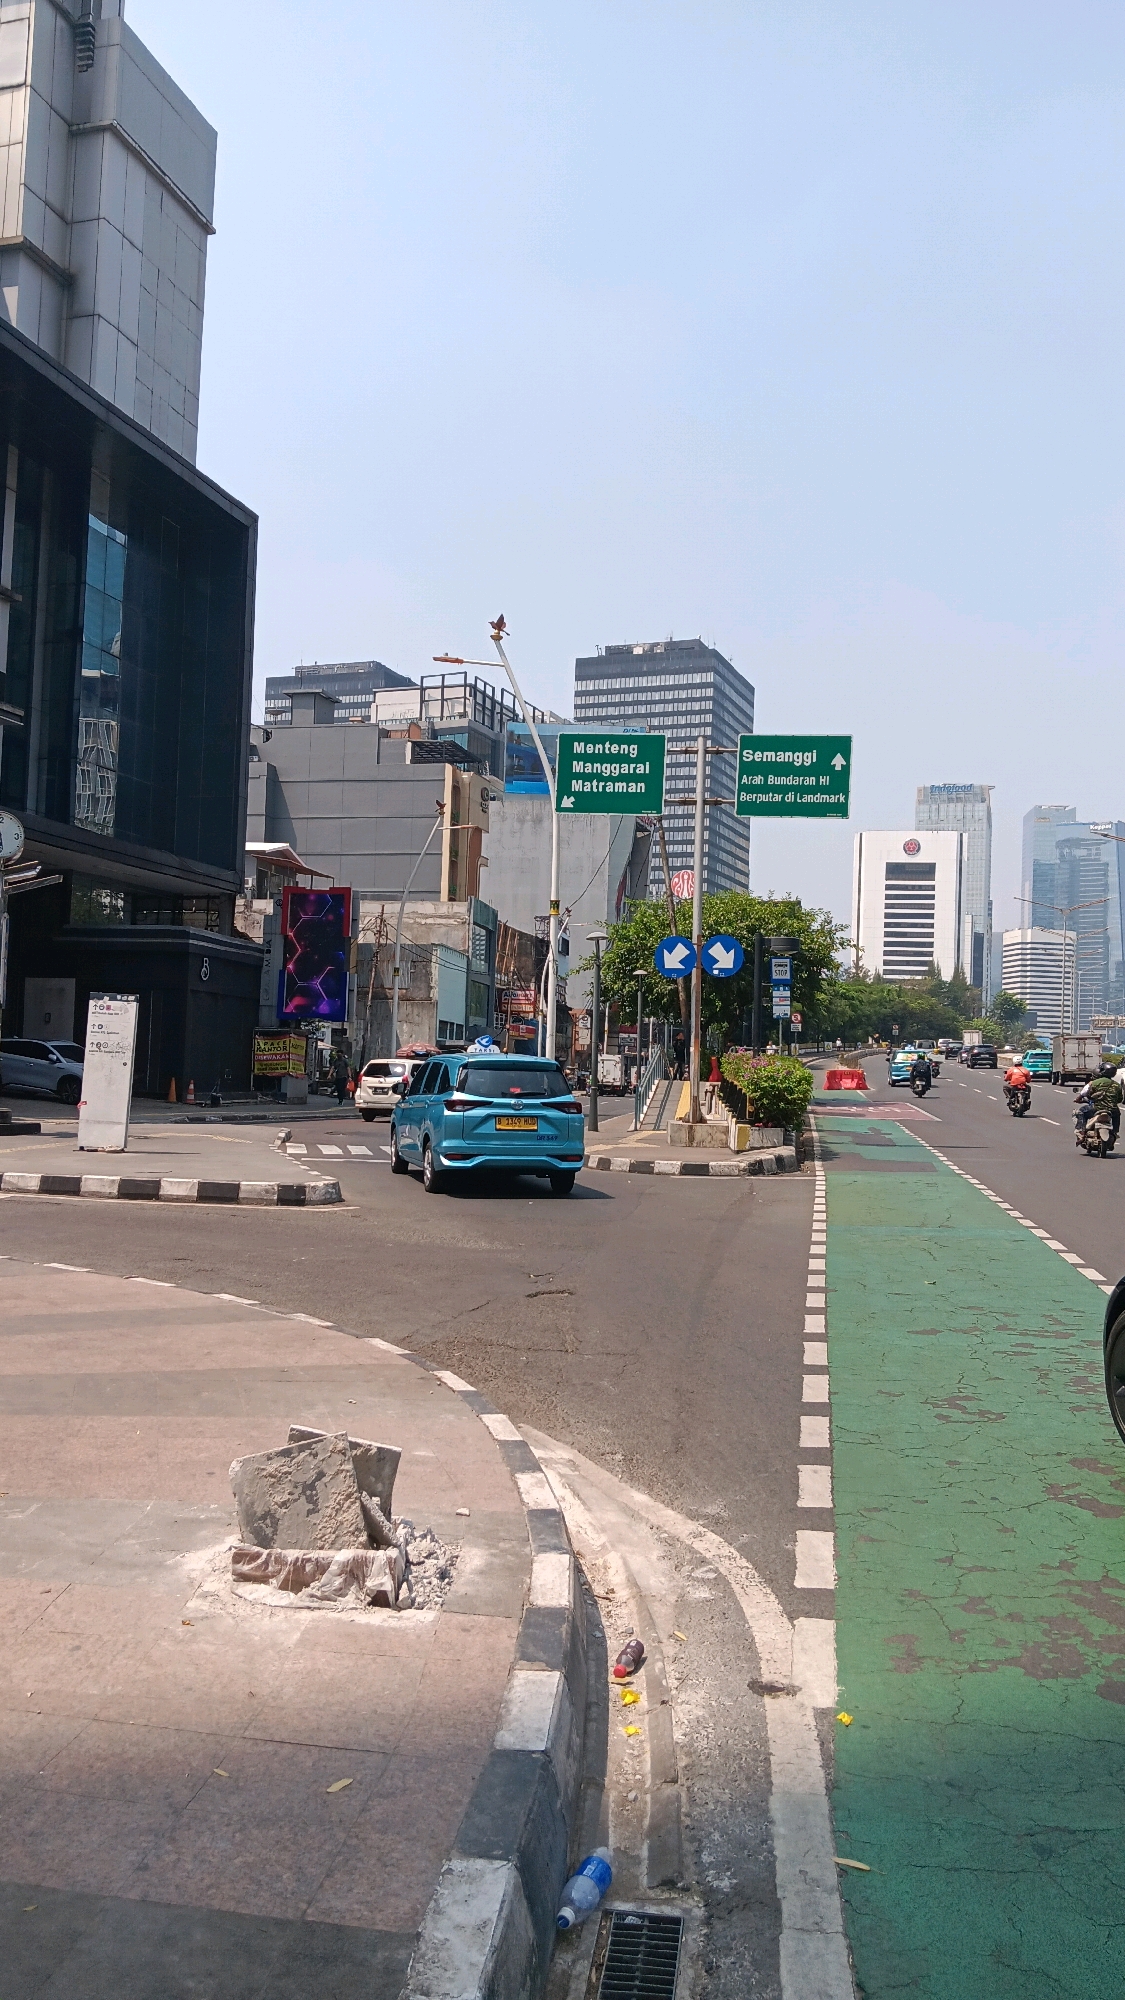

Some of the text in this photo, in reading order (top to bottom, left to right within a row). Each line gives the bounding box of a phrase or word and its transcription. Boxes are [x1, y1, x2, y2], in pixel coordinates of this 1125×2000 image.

[573, 740, 638, 758] Menteng
[742, 749, 817, 767] Semanggi
[572, 760, 650, 777] Manggarai
[571, 778, 646, 793] Matraman
[741, 774, 830, 786] Arah Bundaran HI
[930, 784, 973, 795] Indofood
[739, 791, 845, 804] Berputar di Landmark
[1089, 823, 1112, 831] Keppel
[774, 969, 788, 977] STOP
[256, 1045, 288, 1053] KANTOR
[497, 1117, 502, 1125] B
